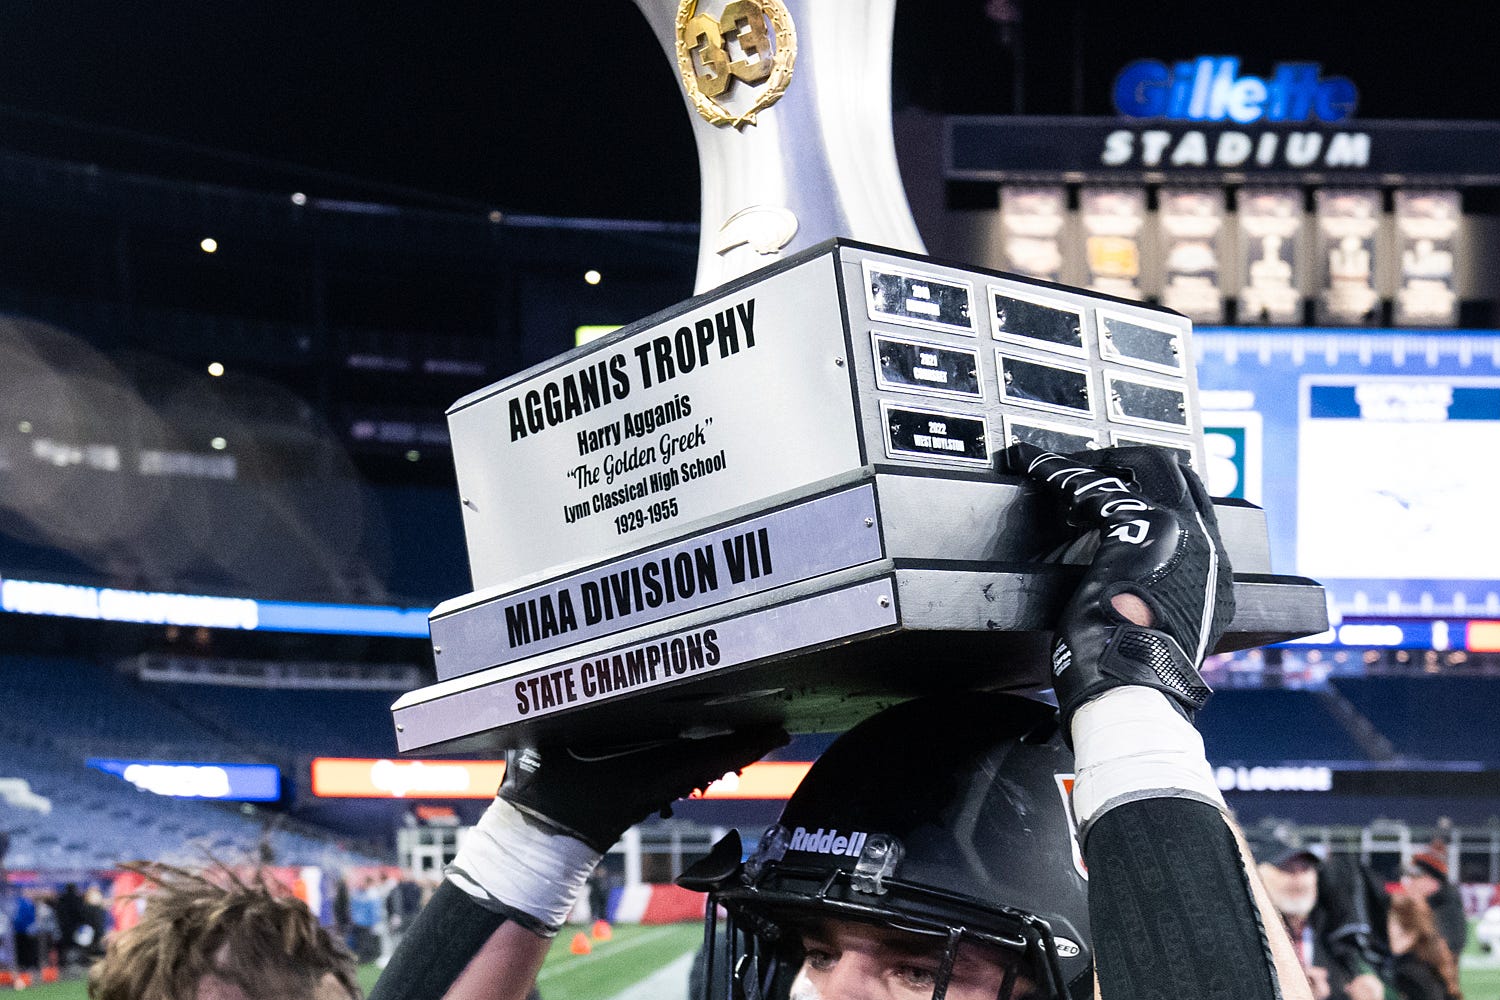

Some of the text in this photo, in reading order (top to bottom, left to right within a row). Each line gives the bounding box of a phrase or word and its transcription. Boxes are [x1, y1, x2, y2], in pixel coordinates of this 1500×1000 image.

[1114, 56, 1358, 123] Gillette
[1103, 130, 1371, 166] STADIUM
[508, 298, 756, 442] AGGANIS TROPHY
[577, 393, 692, 457] Harry Agganis
[928, 421, 947, 436] 2022
[563, 449, 727, 524] Lynn Classical High School
[603, 446, 657, 485] Golden
[614, 497, 679, 536] 1929-1955
[504, 527, 773, 649] MIAA DIVISION VII
[514, 628, 721, 715] STATE CHAMPIONS
[1236, 765, 1332, 792] LOUNGE
[788, 826, 868, 858] Riddell
